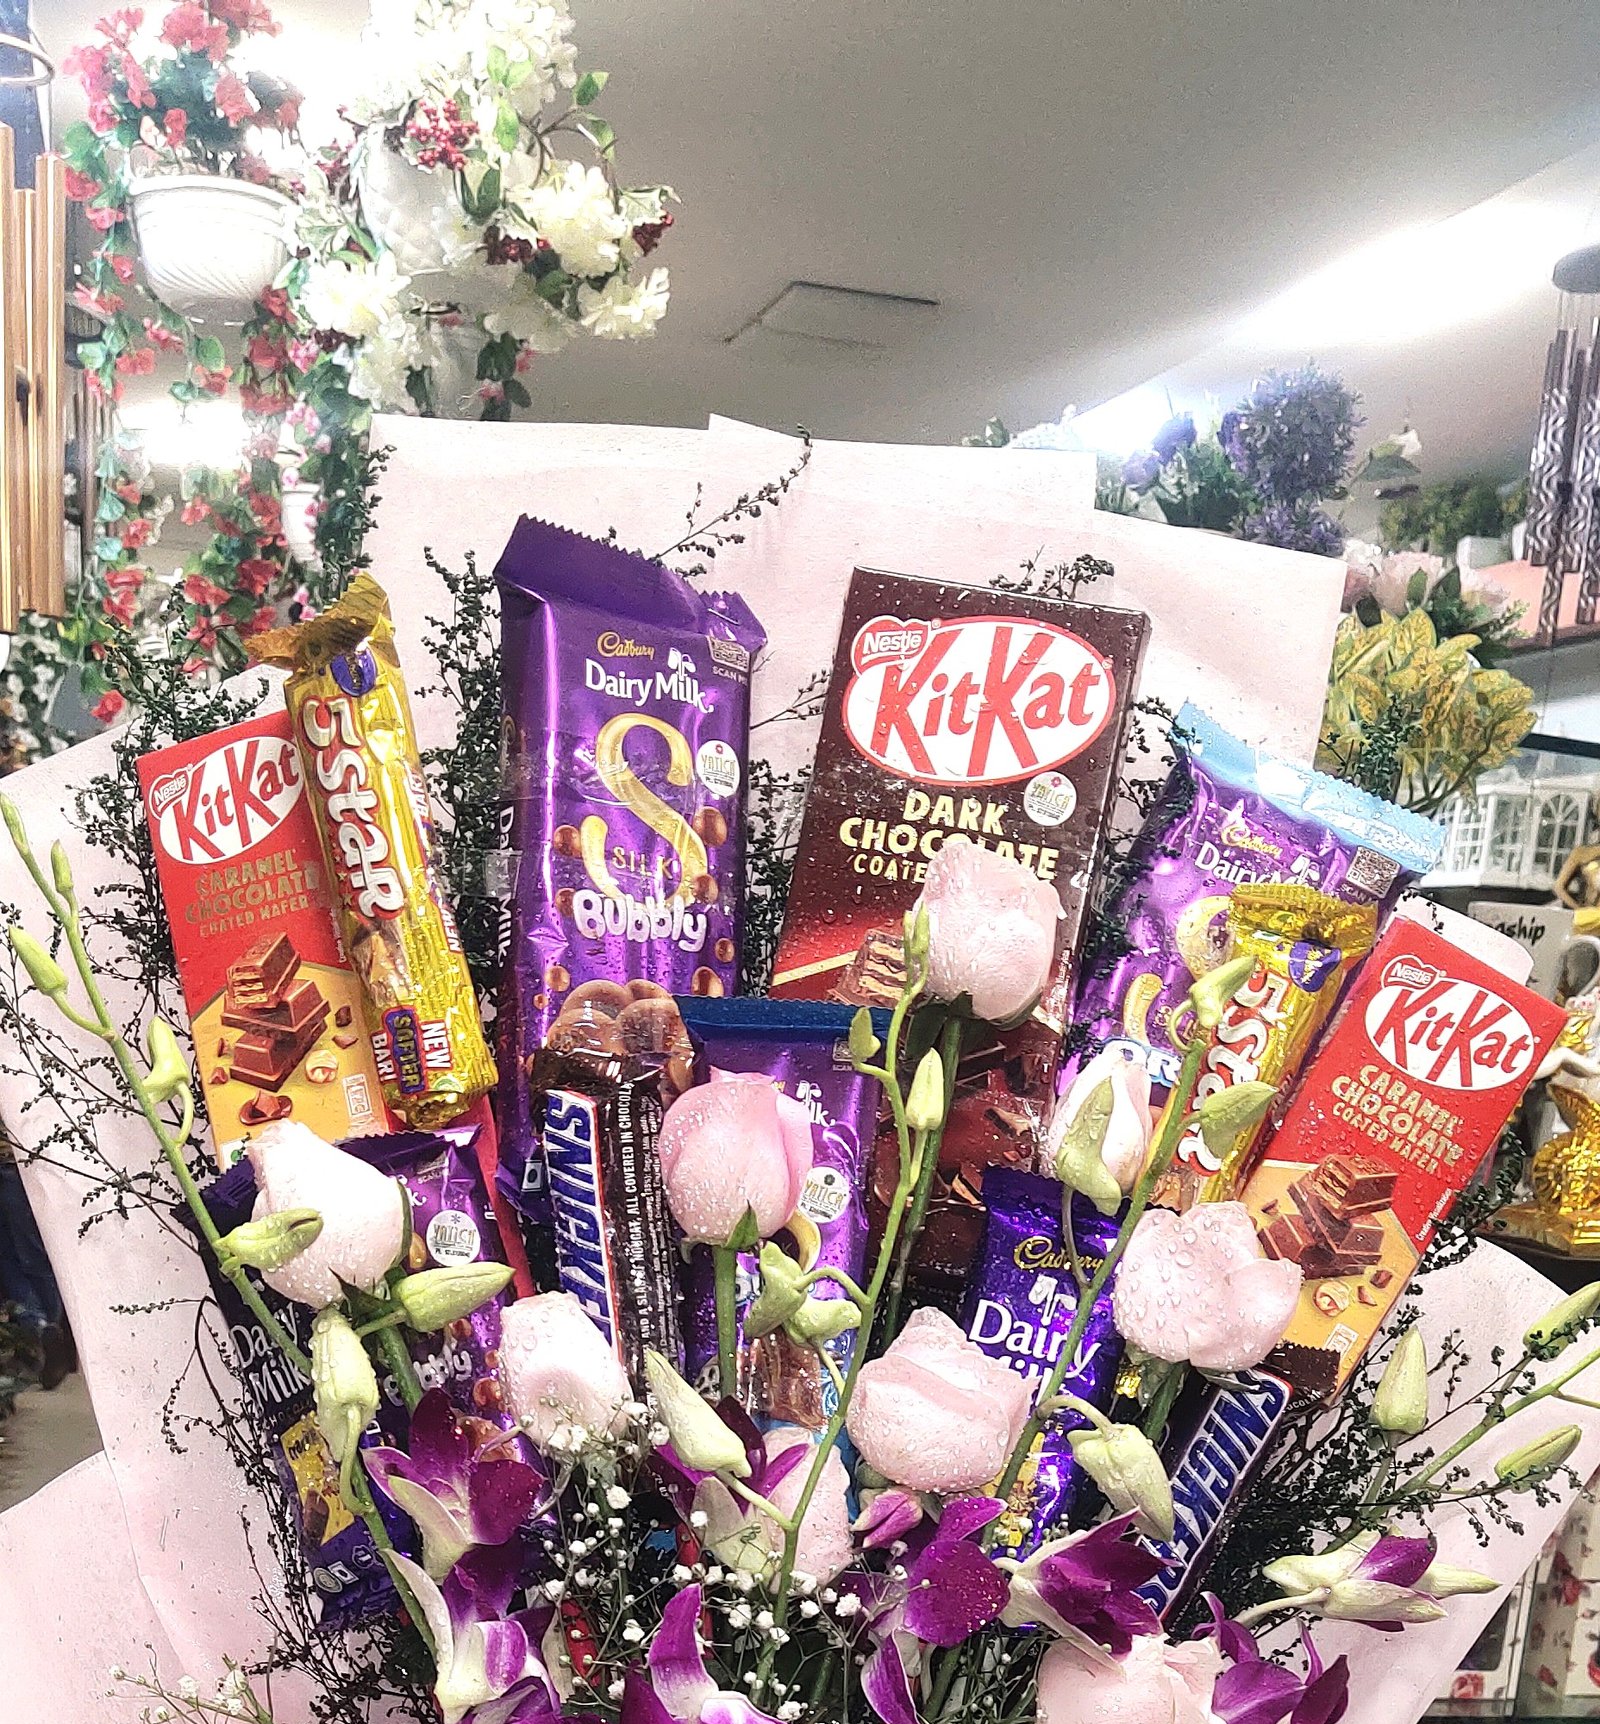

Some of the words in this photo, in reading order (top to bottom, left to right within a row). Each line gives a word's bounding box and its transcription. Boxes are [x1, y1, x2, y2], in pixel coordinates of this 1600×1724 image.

[597, 630, 655, 661] Cadbury
[585, 658, 653, 706] Dairy
[655, 664, 715, 713] Milk
[712, 665, 737, 682] SCAN
[870, 626, 1101, 778] KitKat
[172, 739, 300, 861] KitKat
[902, 789, 1008, 837] DARK
[195, 851, 297, 896] CARAMEL
[611, 846, 674, 880] SILK
[839, 817, 1060, 881] CHOCATE
[853, 853, 928, 884] COATE
[260, 895, 309, 921] WAFER
[497, 892, 515, 968] Milk
[572, 888, 708, 952] Bubbly
[371, 1032, 397, 1083] BAR!
[393, 1013, 422, 1088] SOFTER
[420, 1023, 450, 1069] NEW
[1374, 981, 1530, 1088] KitKat
[617, 1081, 635, 1130] CHOCOLA
[1330, 1075, 1465, 1168] CHOCOLATE
[1359, 1063, 1465, 1138] CARAMEL
[620, 1131, 634, 1143] IN
[1332, 1103, 1393, 1149] COATED
[1389, 1137, 1439, 1176] WAFER
[621, 1146, 638, 1194] COVERED
[626, 1196, 640, 1216] ALL
[628, 1217, 646, 1262] NOUGAT,
[229, 1301, 300, 1370] Day
[640, 1318, 650, 1339] AND
[969, 1299, 1102, 1378] Dairy
[248, 1354, 312, 1414] Milk
